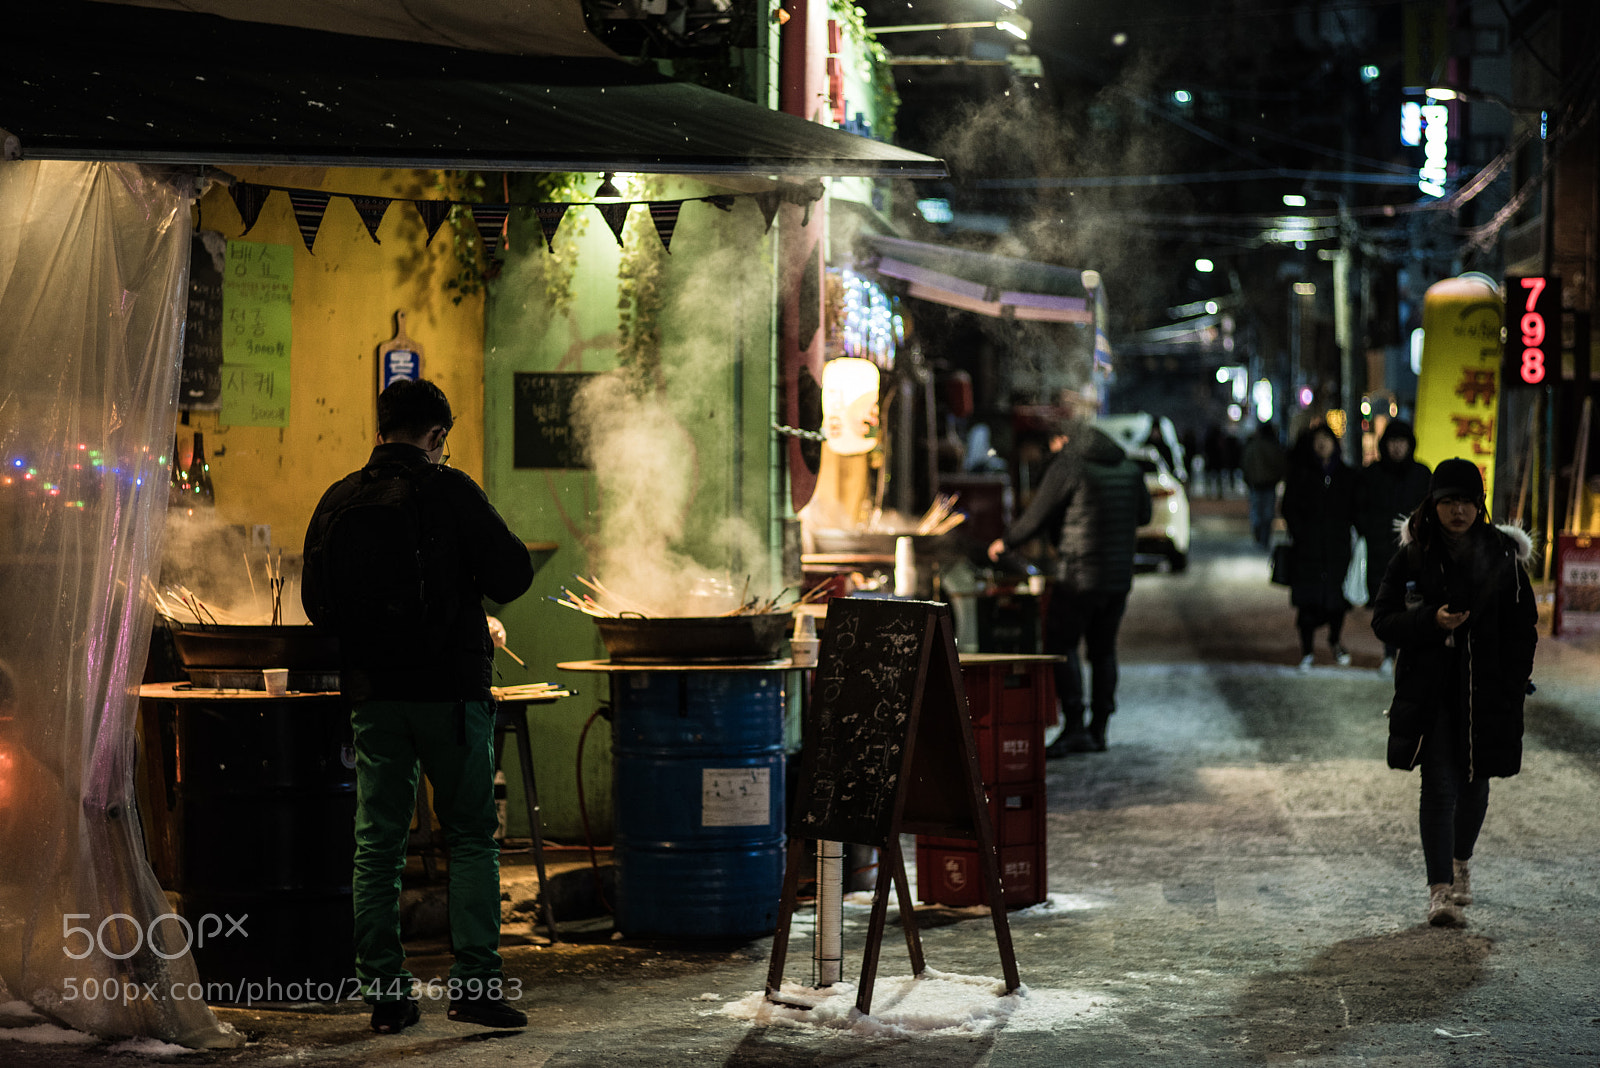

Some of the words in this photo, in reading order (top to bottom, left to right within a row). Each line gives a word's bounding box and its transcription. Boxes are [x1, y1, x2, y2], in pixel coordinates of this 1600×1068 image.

[231, 243, 281, 279] 뱅쇼
[229, 307, 267, 338] 정종
[1520, 277, 1547, 384] 798
[226, 370, 275, 399] 사케
